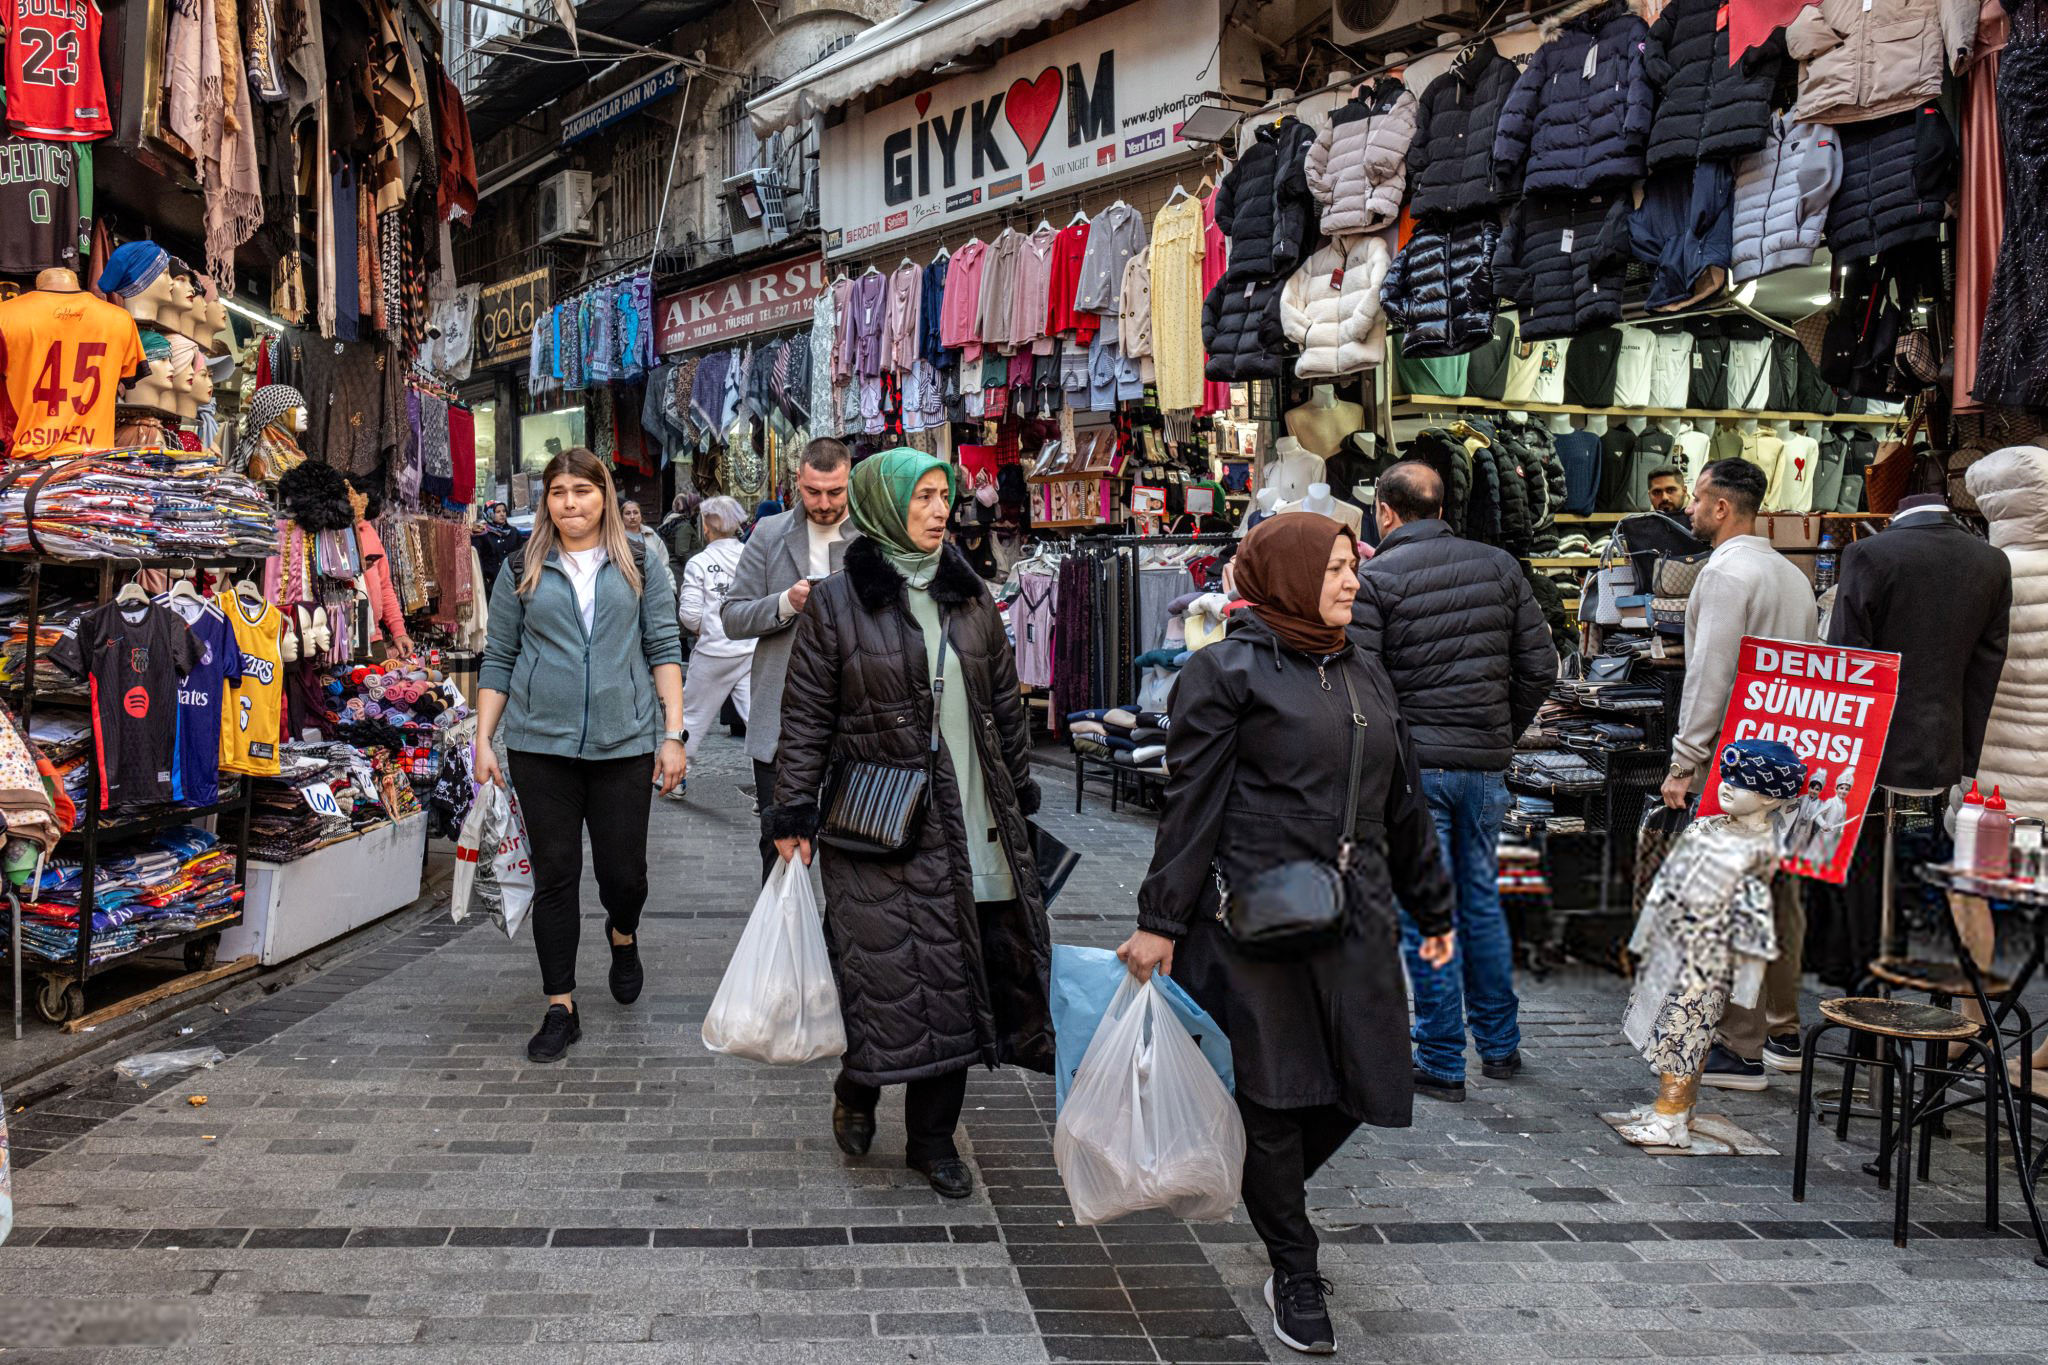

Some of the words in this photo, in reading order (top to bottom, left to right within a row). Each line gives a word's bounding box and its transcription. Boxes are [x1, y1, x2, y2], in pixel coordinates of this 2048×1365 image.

[20, 27, 79, 87] 23
[622, 87, 641, 111] HAN
[643, 79, 657, 100] NO
[0, 143, 72, 188] CELTICS
[29, 189, 51, 224] 0
[913, 203, 941, 218] Penti
[854, 222, 881, 242] ERDEM
[33, 340, 107, 416] 45
[1755, 647, 1876, 687] DENİZ
[1744, 678, 1875, 728] SÜNNET
